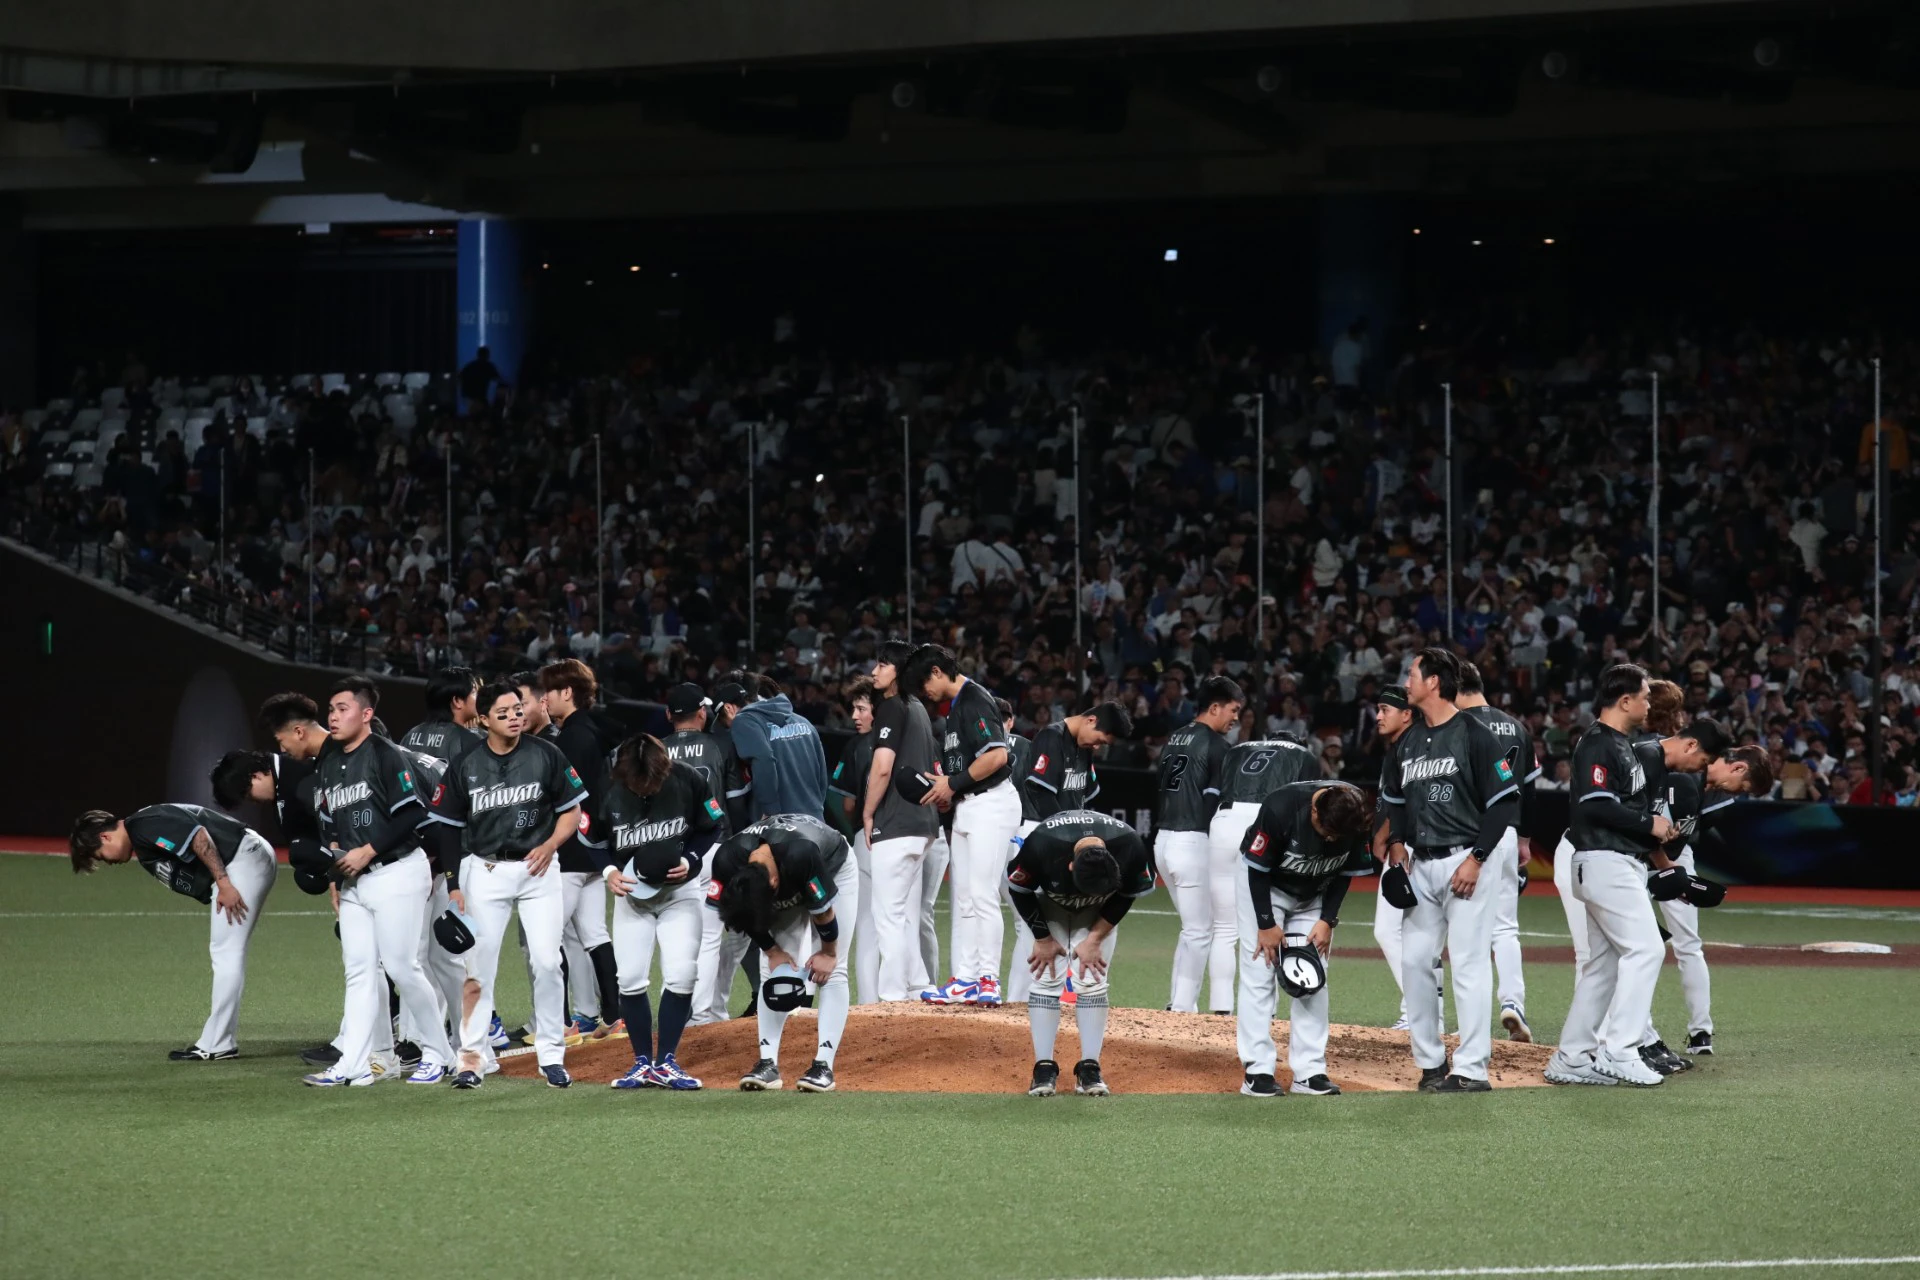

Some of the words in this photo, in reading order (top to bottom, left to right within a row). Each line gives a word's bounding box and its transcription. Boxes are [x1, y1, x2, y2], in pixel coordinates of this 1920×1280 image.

[1490, 722, 1516, 736] CHEN
[427, 734, 445, 748] WEI
[684, 744, 704, 758] WU
[1241, 750, 1278, 774] 6
[469, 782, 544, 816] Taiwan
[1428, 784, 1454, 801] 28
[1046, 816, 1084, 829] CHIANG
[612, 816, 689, 852] Taiwan
